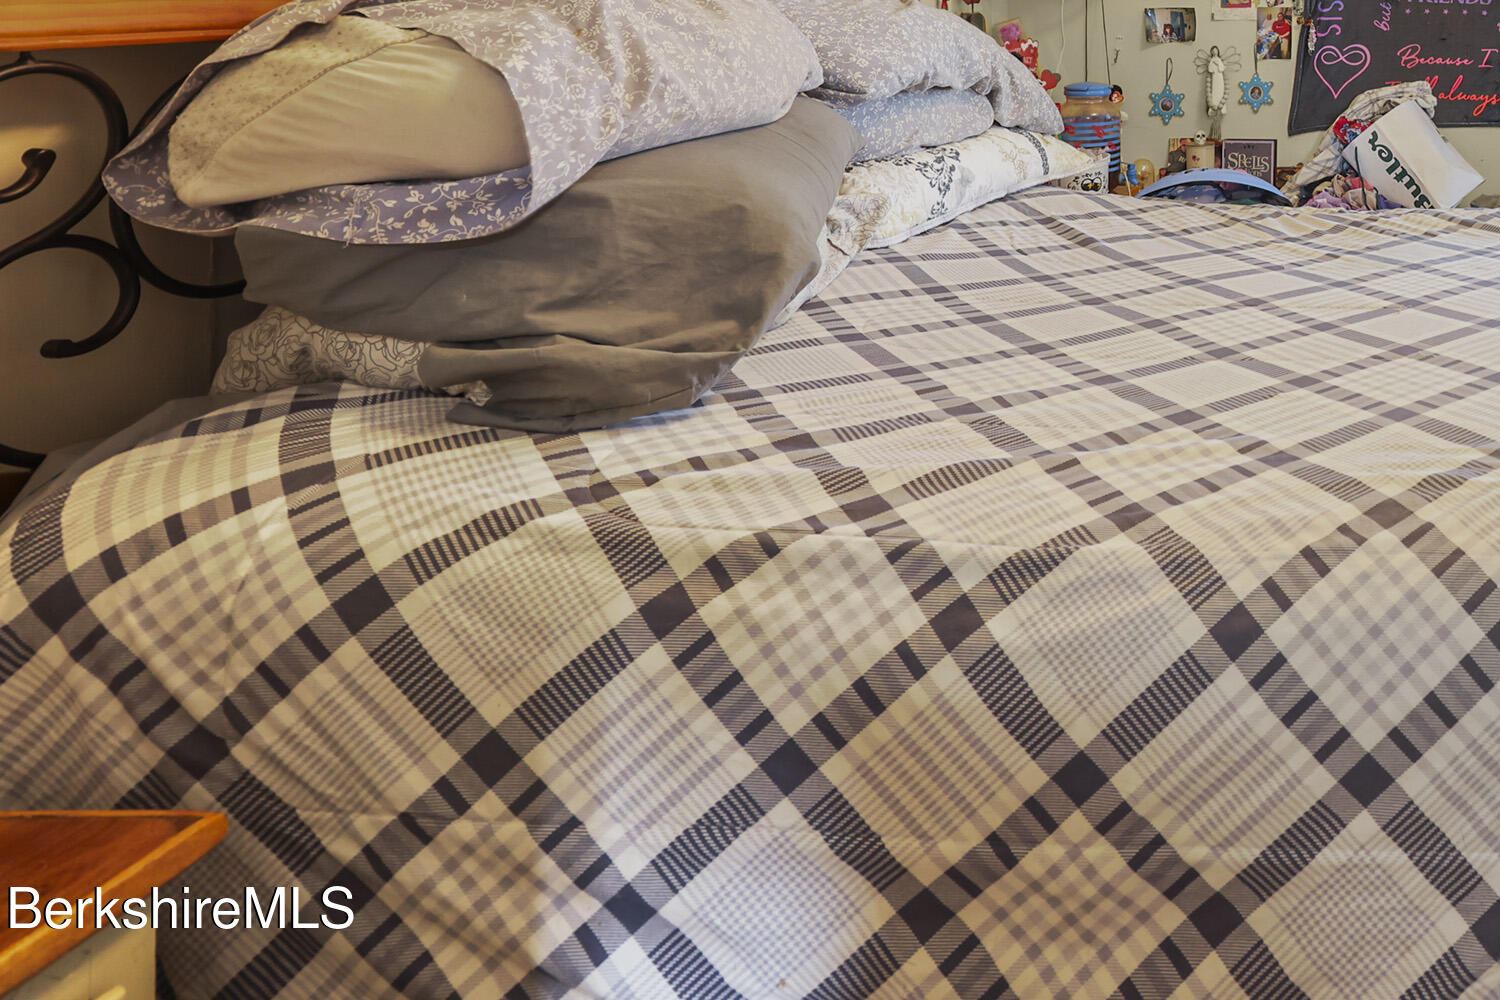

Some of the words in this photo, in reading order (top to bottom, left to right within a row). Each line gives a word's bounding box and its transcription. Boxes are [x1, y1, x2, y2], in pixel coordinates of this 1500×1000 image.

[1374, 1, 1392, 31] but
[1397, 43, 1474, 68] Because
[1477, 48, 1499, 69] I
[1437, 75, 1500, 116] always
